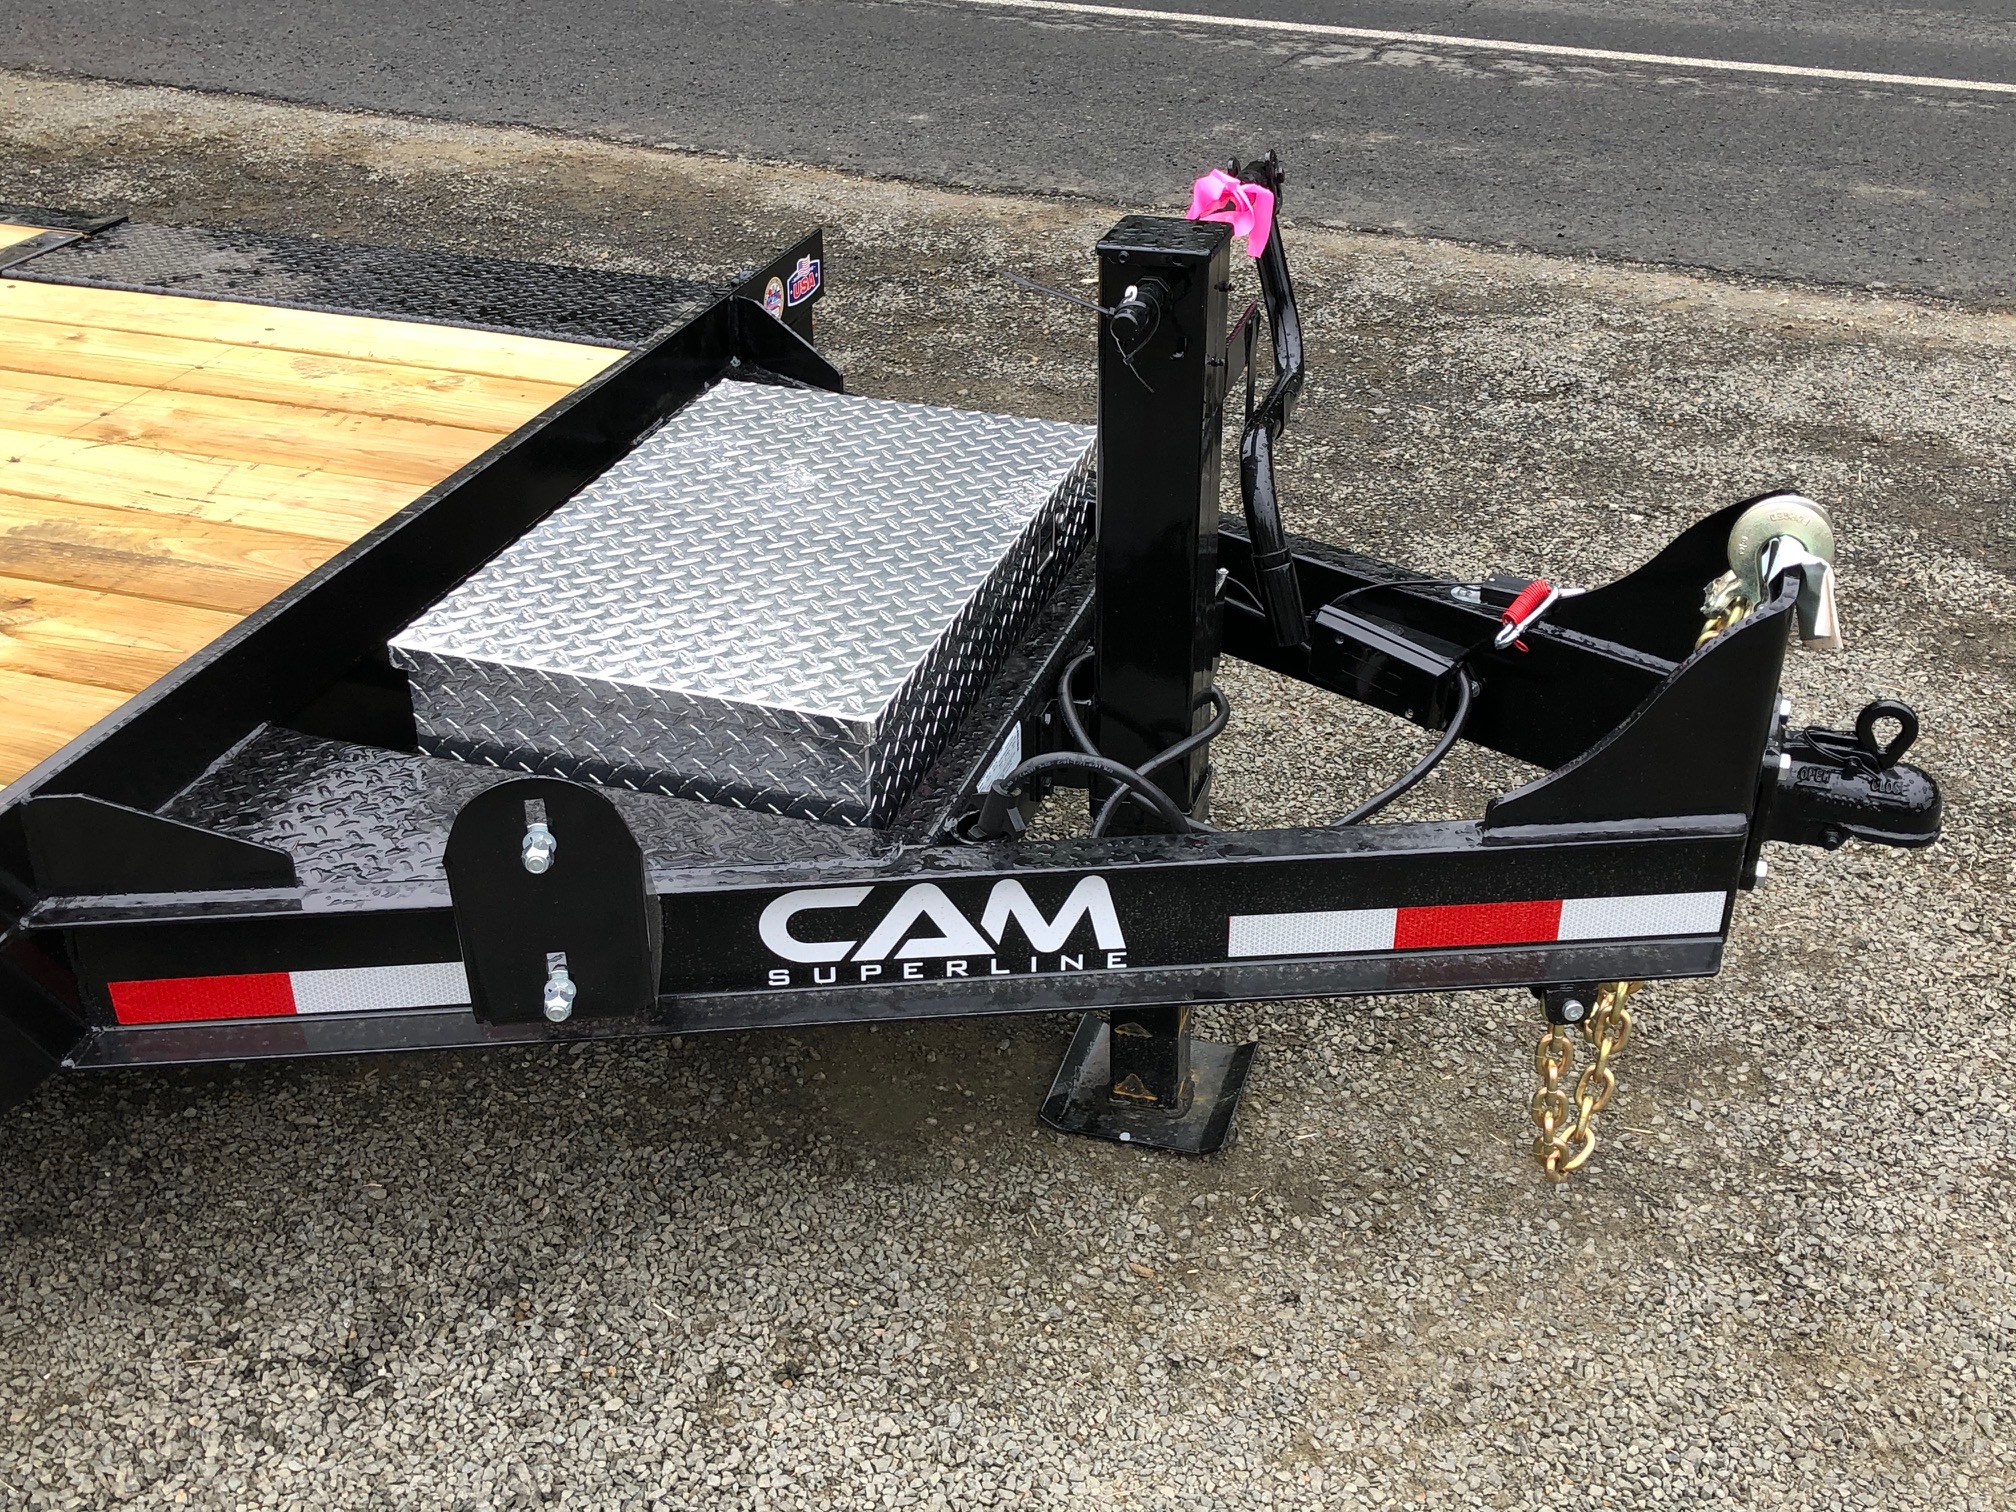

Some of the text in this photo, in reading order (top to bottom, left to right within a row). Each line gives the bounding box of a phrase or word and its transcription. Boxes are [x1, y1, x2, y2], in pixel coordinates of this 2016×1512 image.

[793, 272, 815, 299] USA
[1870, 777, 1910, 797] CLOSE
[758, 875, 1126, 963] CAM
[768, 951, 1127, 985] SUPERLINE
